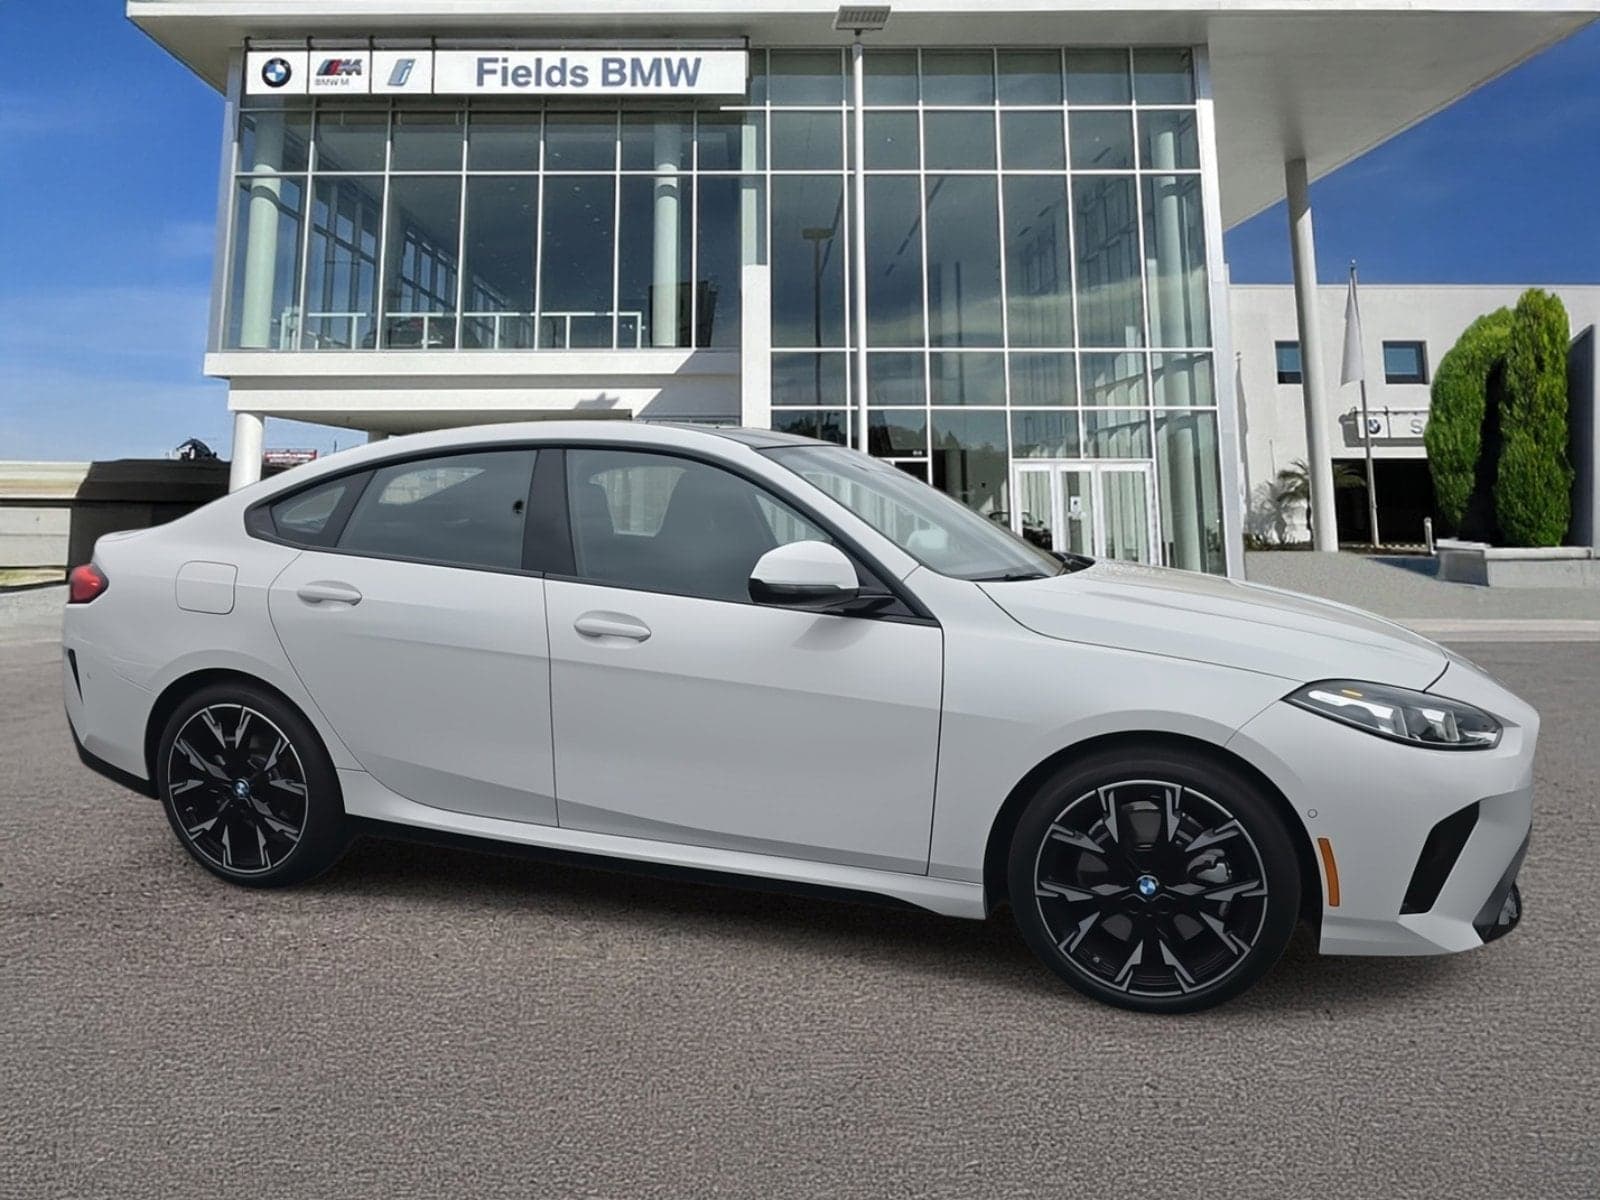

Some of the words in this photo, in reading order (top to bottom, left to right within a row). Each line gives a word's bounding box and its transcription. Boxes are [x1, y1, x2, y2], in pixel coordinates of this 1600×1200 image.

[476, 57, 589, 87] Fields
[601, 57, 701, 87] BMW
[315, 78, 338, 86] BMW
[340, 78, 350, 86] M
